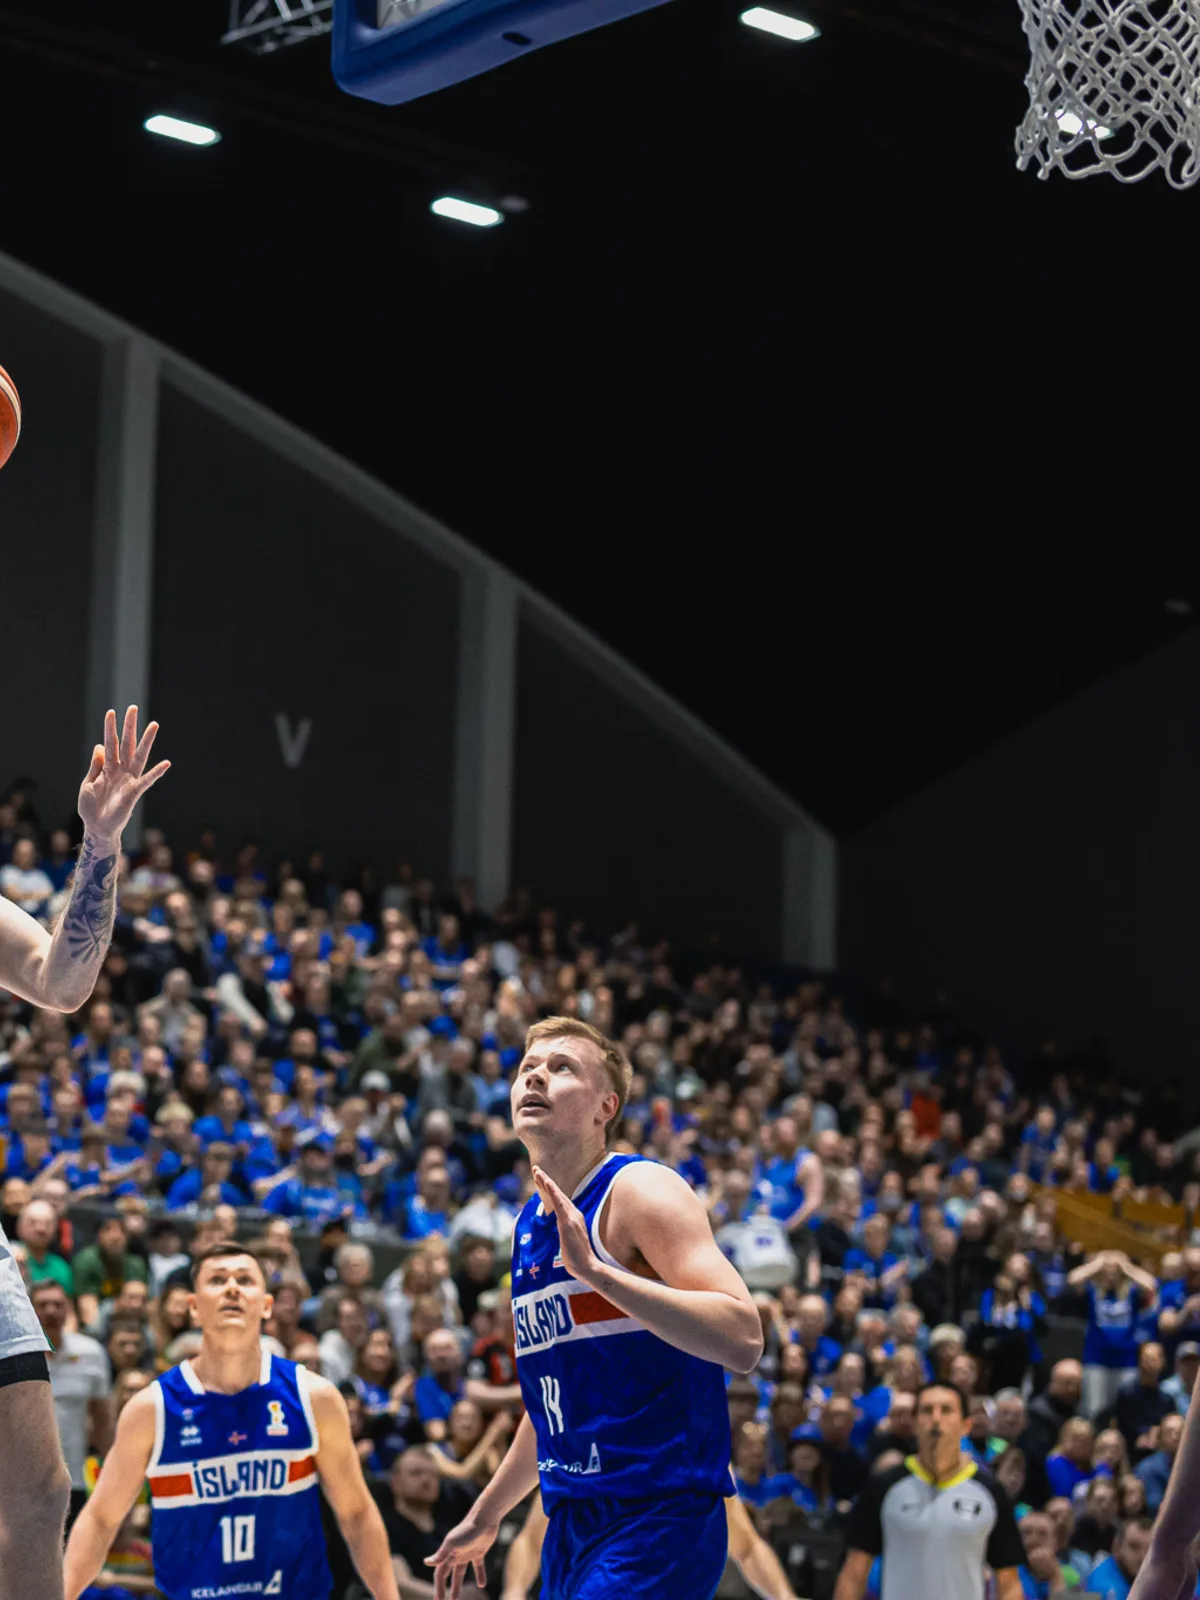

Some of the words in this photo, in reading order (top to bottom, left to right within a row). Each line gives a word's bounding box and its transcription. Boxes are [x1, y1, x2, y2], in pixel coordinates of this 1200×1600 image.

[275, 711, 313, 768] V
[539, 1376, 564, 1437] 14
[193, 1459, 287, 1498] ÍSLAND
[220, 1515, 256, 1563] 10
